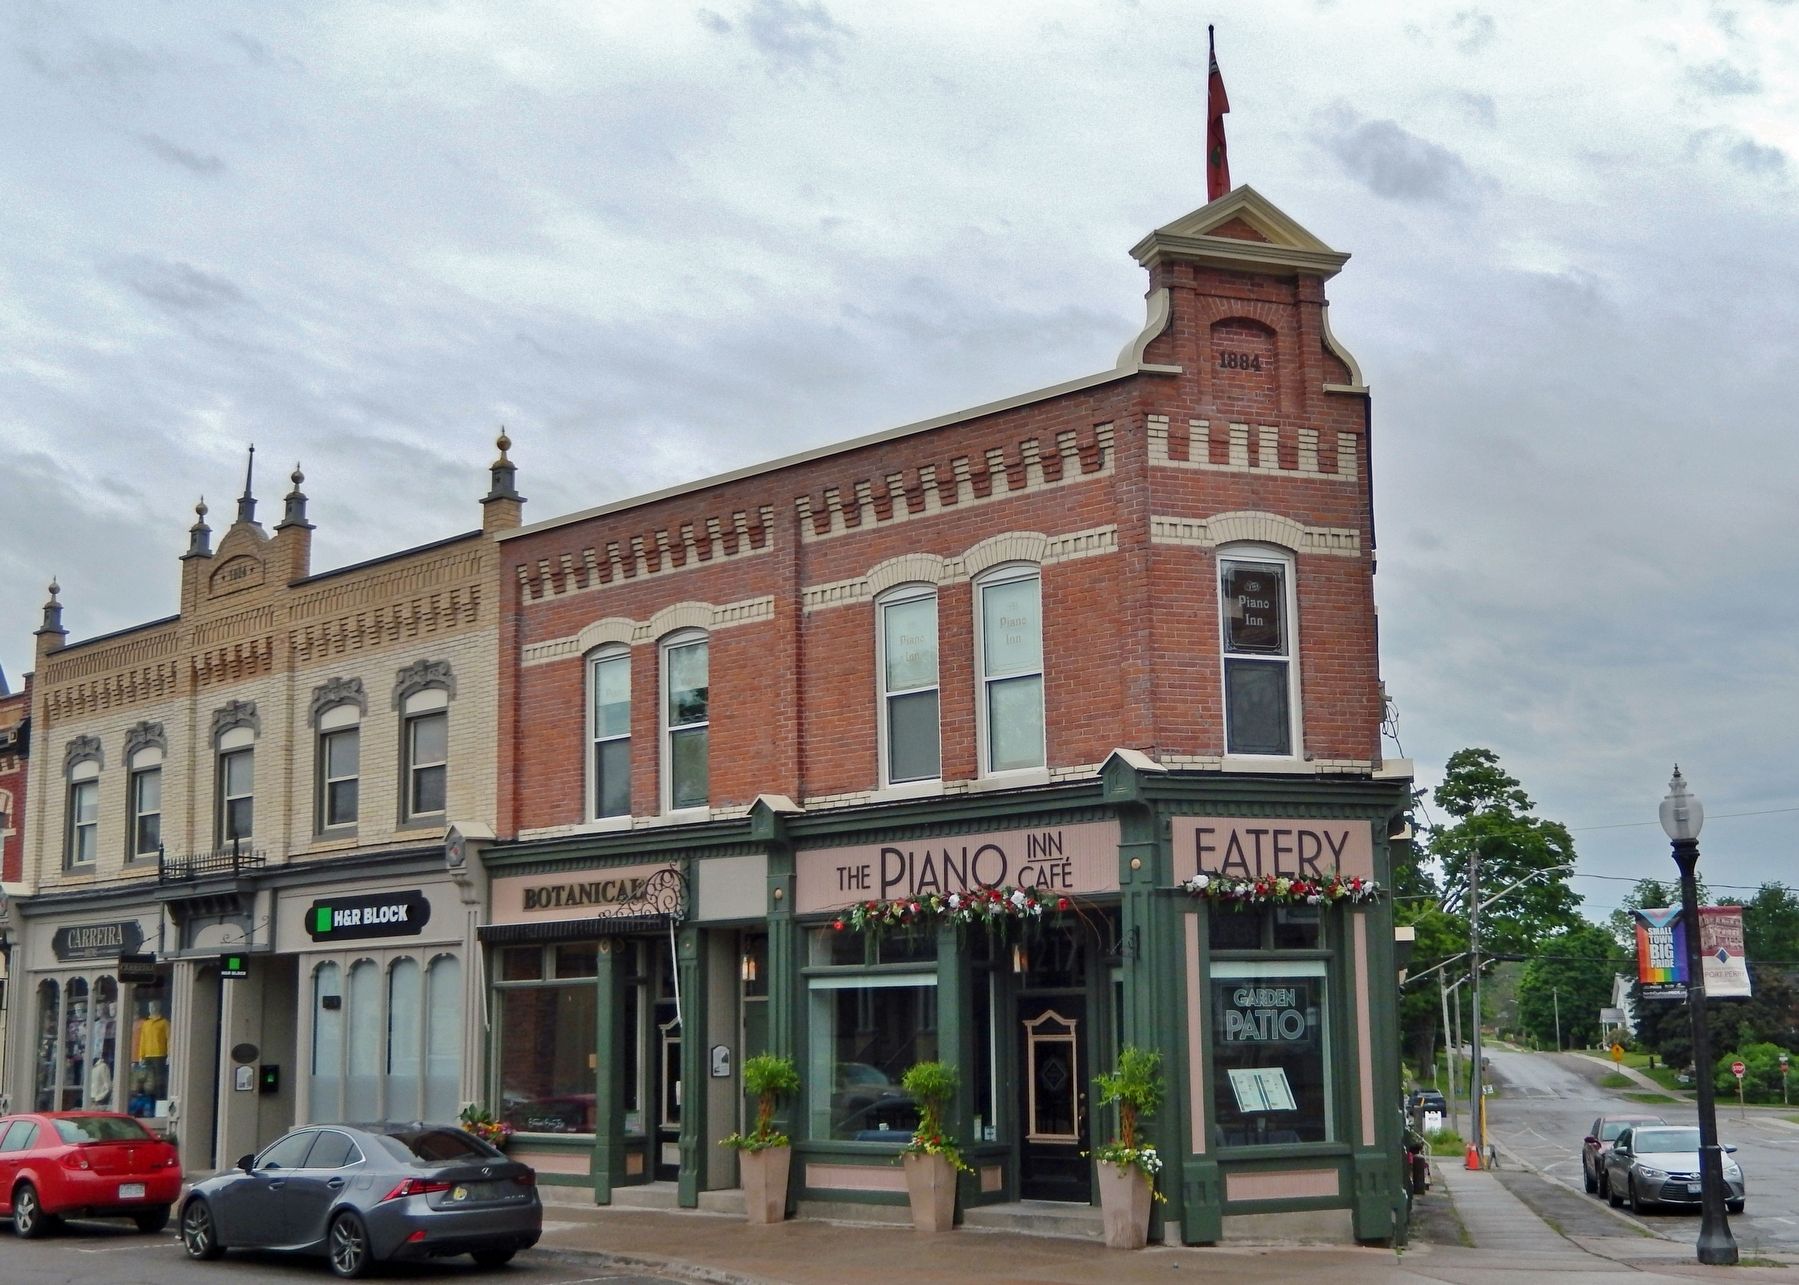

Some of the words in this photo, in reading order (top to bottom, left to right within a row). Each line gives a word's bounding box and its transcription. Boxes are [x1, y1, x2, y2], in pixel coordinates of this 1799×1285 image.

[1219, 351, 1261, 371] 1884
[1238, 595, 1270, 608] Piano
[1245, 613, 1264, 626] Inn
[1027, 831, 1062, 858] INN
[1196, 828, 1349, 878] EATERY
[837, 865, 871, 890] THE
[881, 844, 1007, 899] PIANO
[1018, 857, 1073, 888] CAFÉ
[523, 878, 644, 909] BOTANICAL
[334, 908, 361, 927] H&R
[363, 904, 408, 925] BLOCK
[68, 924, 123, 948] CARREIRA
[1648, 927, 1673, 935] SMALL
[1649, 936, 1673, 944] TOWN
[1650, 944, 1674, 959] BIG
[1651, 959, 1675, 968] PRIDE
[1233, 988, 1296, 1007] GARDEN
[1226, 1009, 1305, 1040] PATIO
